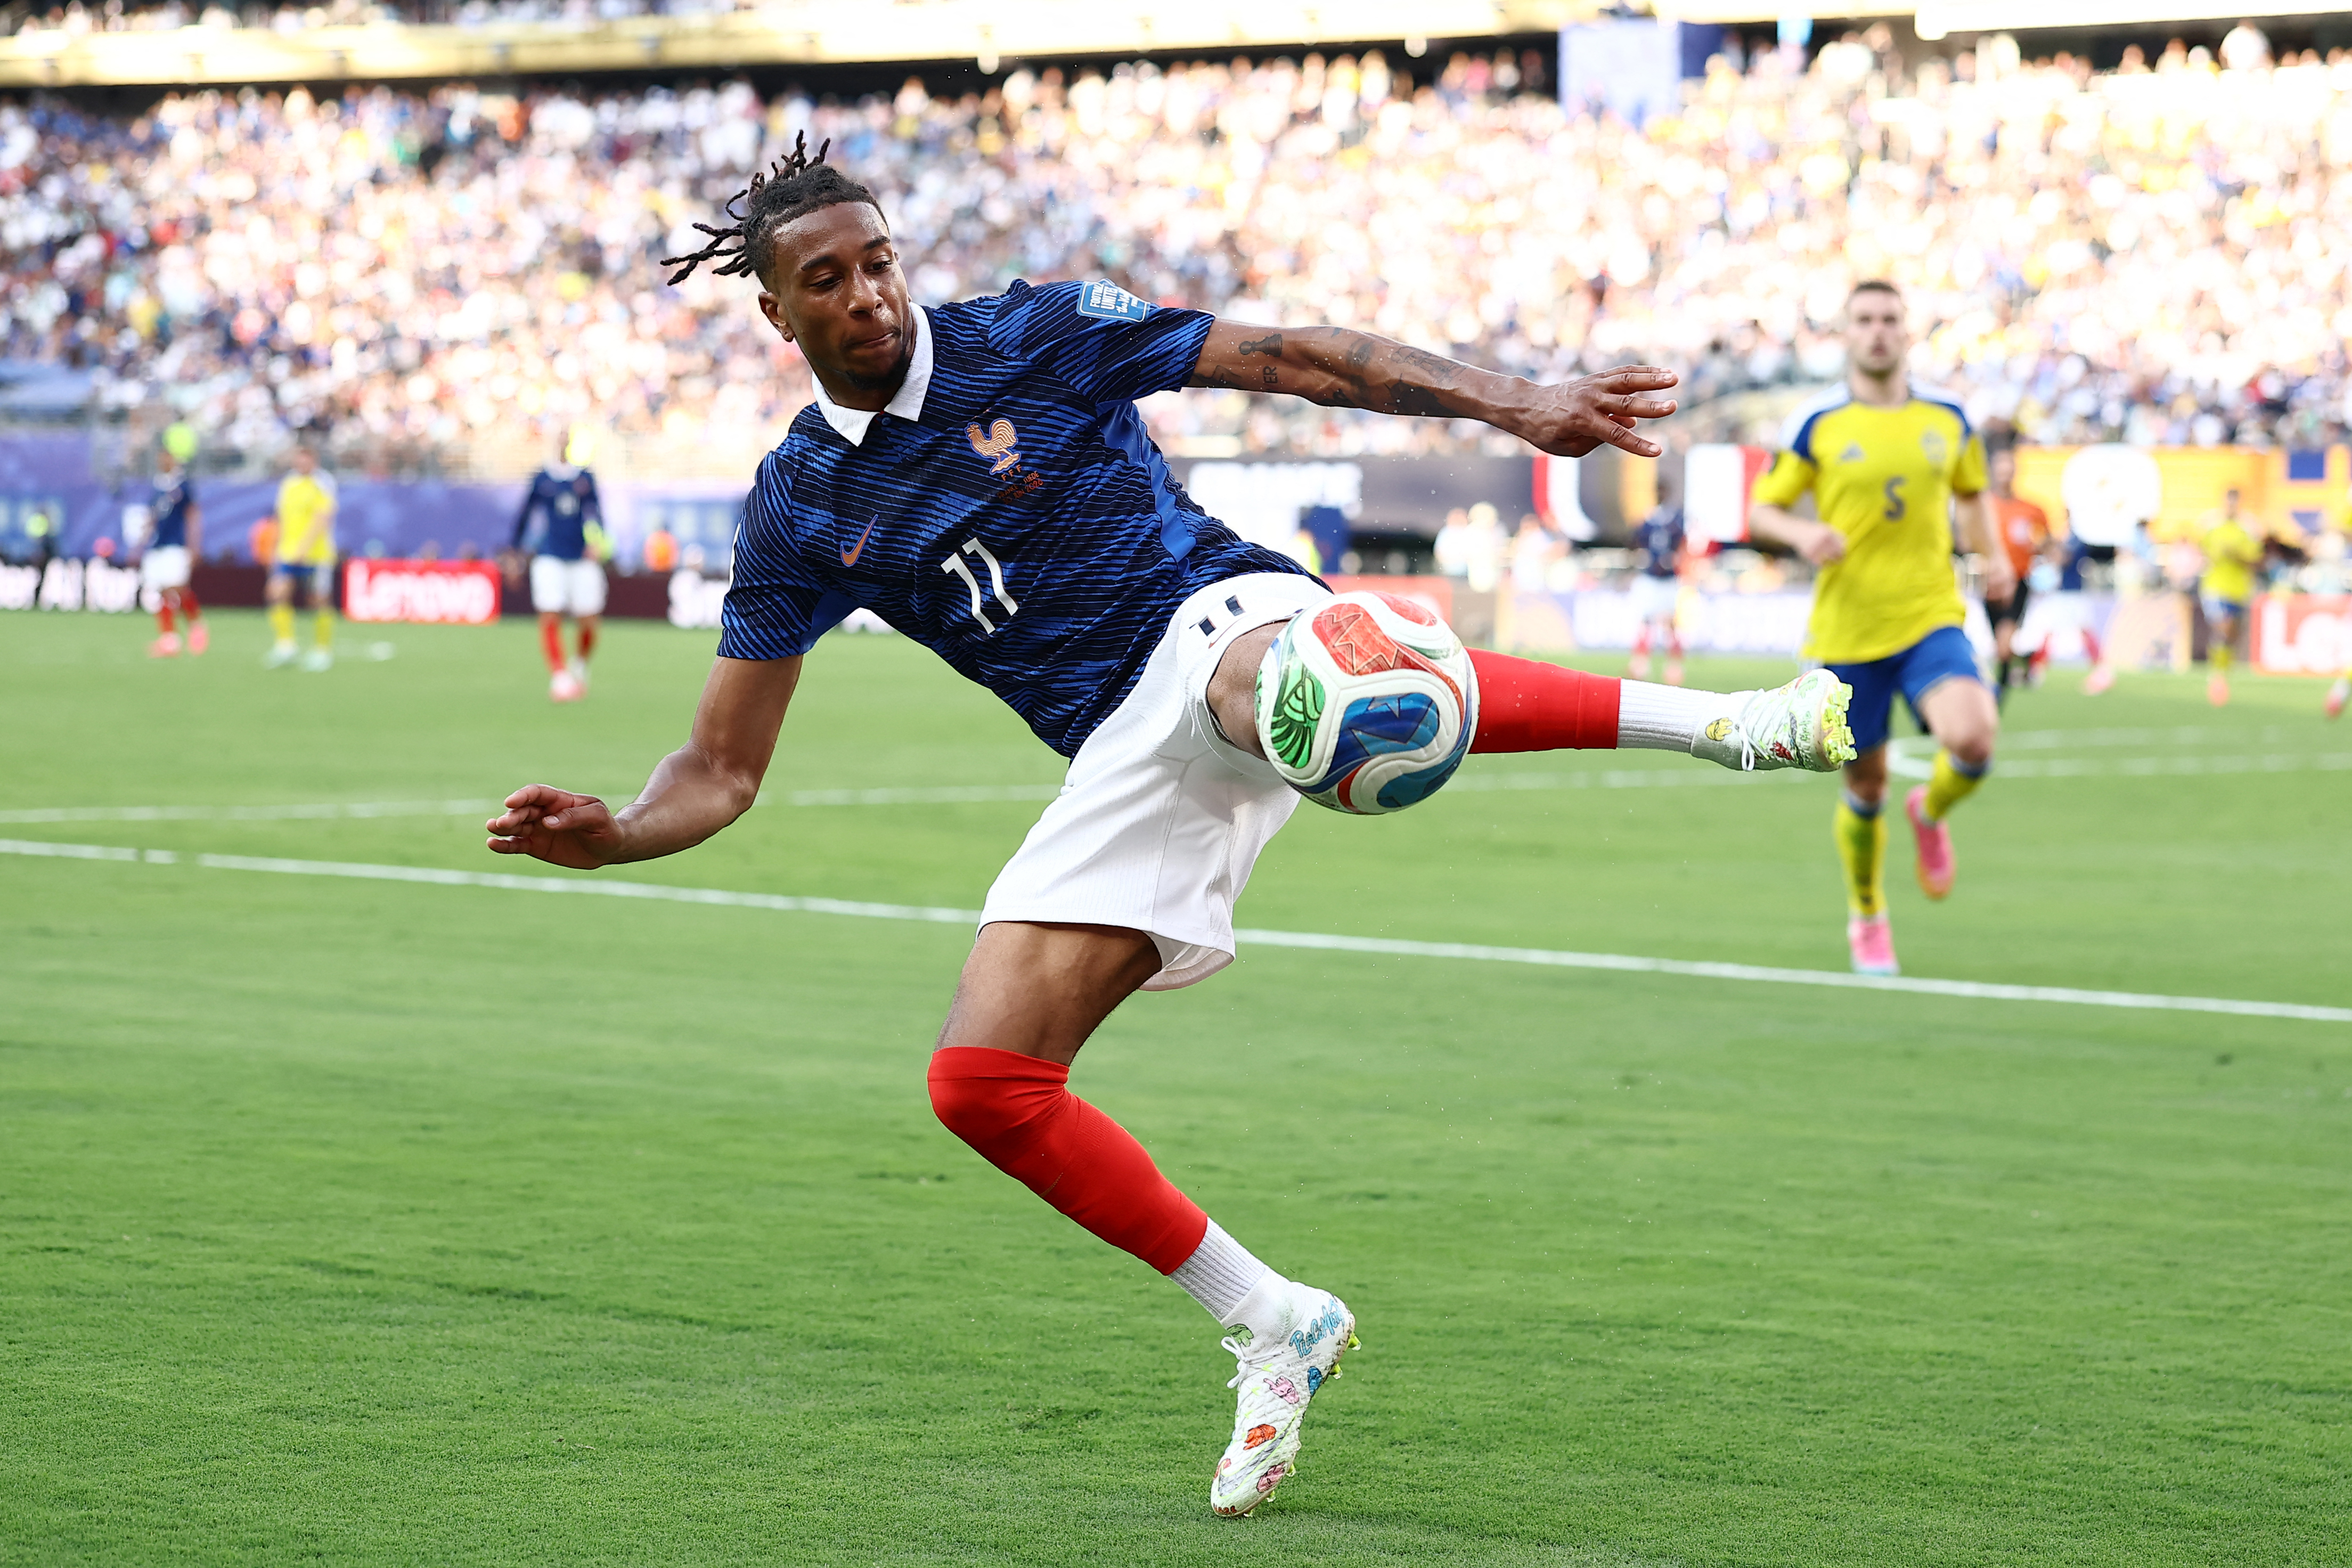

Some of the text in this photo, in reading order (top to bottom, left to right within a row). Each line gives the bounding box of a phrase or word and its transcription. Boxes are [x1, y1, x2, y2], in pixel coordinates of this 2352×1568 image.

[1263, 366, 1278, 391] ER
[347, 559, 496, 624] Lenovo
[941, 536, 1019, 634] 11
